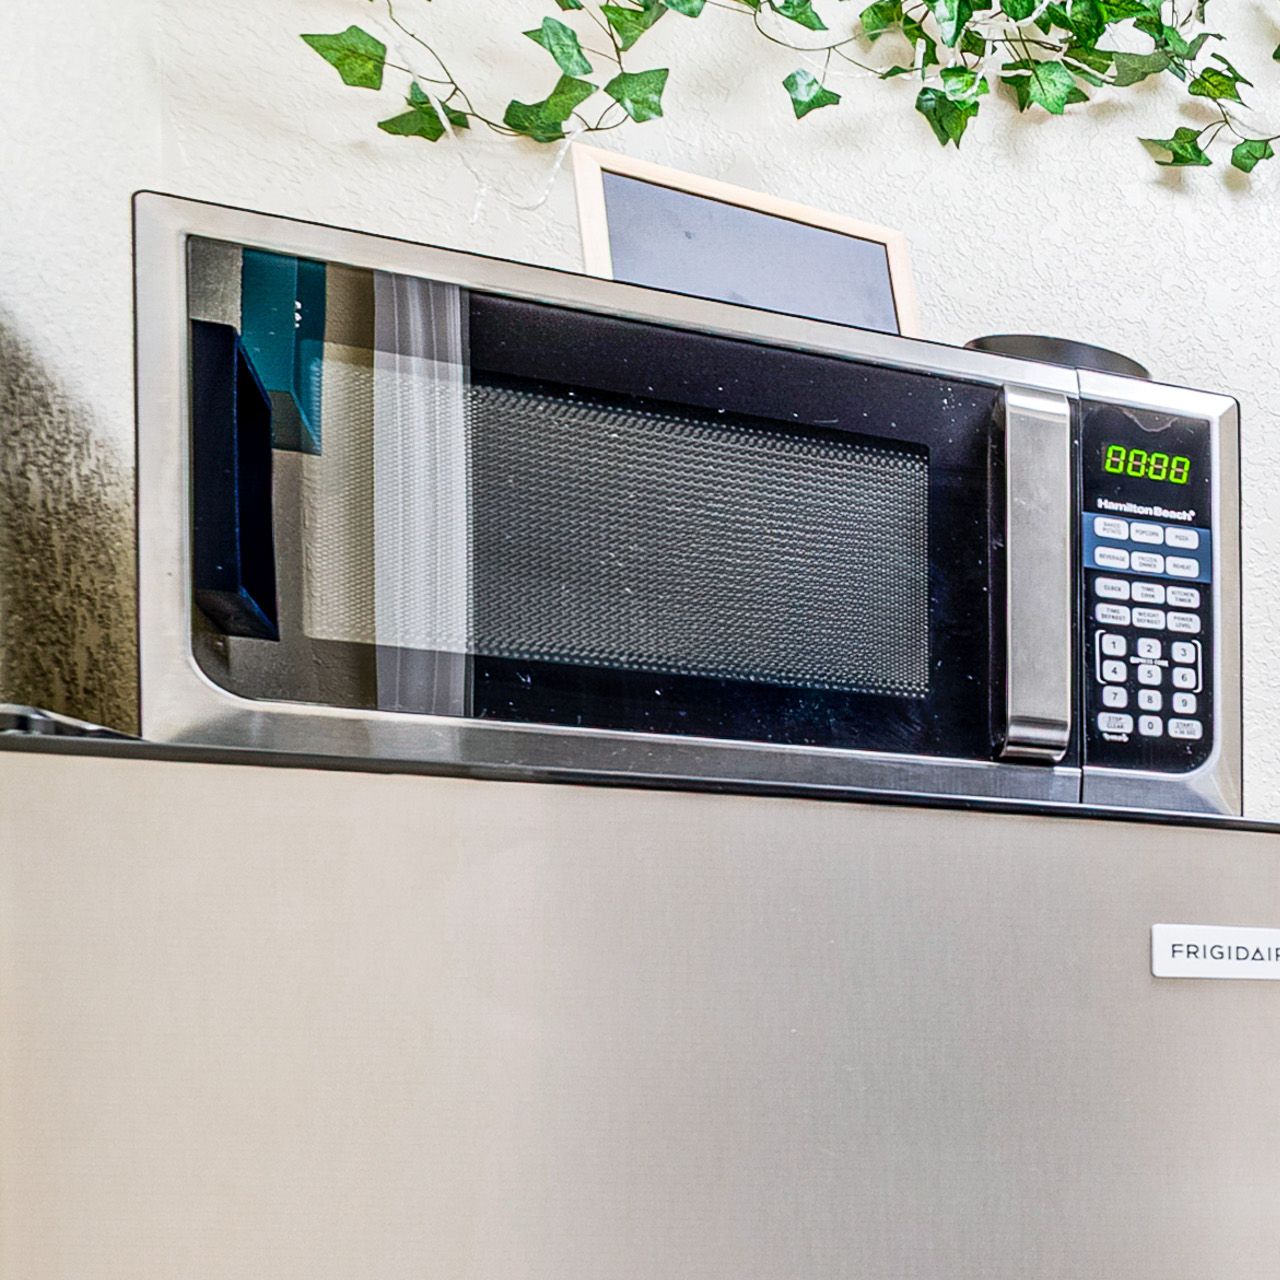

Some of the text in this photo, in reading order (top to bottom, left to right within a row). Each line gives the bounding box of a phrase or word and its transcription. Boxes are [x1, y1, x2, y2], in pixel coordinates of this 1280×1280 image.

[1097, 498, 1193, 521] Hamilton Beach
[1111, 641, 1117, 649] 1
[1146, 644, 1153, 653] 2
[1180, 648, 1187, 656] 3
[1111, 666, 1118, 675] 4
[1147, 670, 1153, 678] 5
[1181, 673, 1188, 682] 6
[1112, 692, 1118, 700] 7
[1147, 695, 1153, 704] 8
[1181, 699, 1188, 707] 9
[1147, 721, 1154, 730] 0
